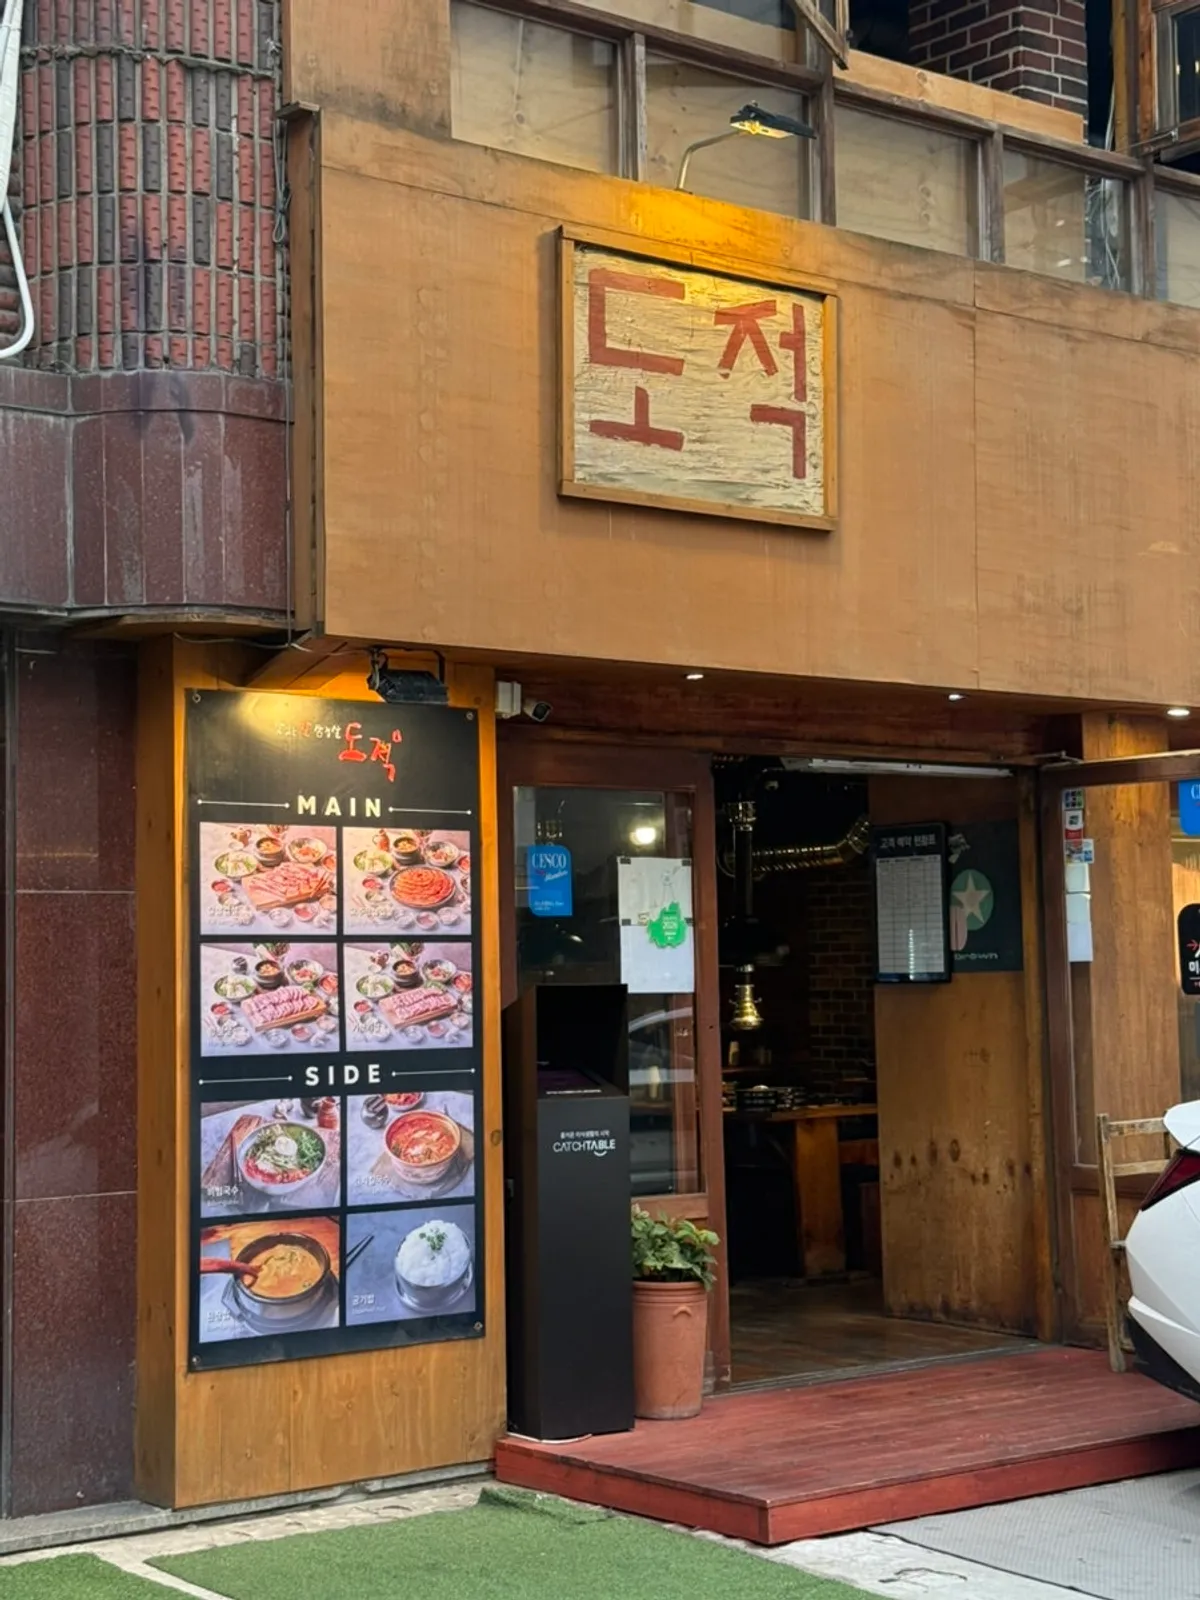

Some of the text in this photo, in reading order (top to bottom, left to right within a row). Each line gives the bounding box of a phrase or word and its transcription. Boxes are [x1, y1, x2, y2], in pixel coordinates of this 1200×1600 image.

[588, 267, 808, 480] 도적
[297, 795, 382, 818] MAIN
[305, 1064, 381, 1086] SIDE
[552, 1138, 617, 1153] CATCHTABLE
